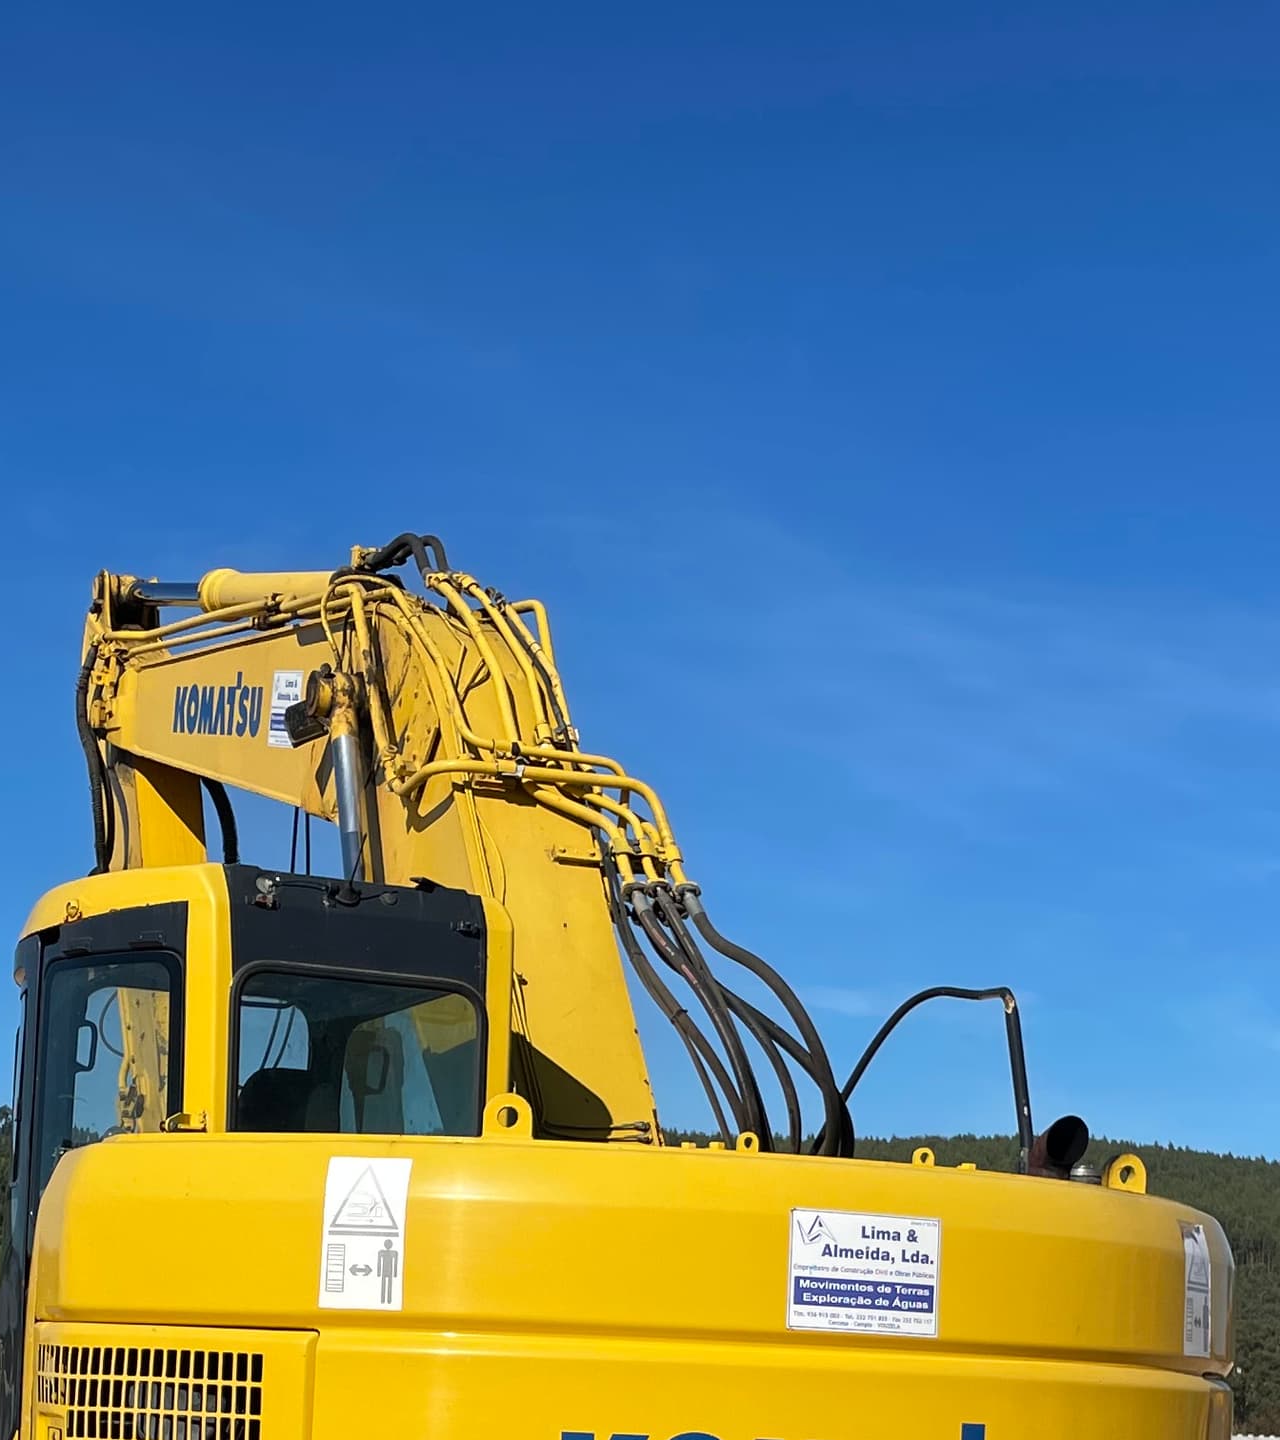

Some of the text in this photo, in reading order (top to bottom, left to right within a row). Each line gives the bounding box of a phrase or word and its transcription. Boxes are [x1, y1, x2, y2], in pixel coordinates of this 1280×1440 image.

[173, 672, 263, 738] KOMATSU
[861, 1225, 919, 1243] Lima &
[821, 1244, 934, 1264] Almeida, Lda.
[799, 1279, 930, 1296] Movimentos de Terras
[803, 1292, 929, 1310] Exploração de Águas
